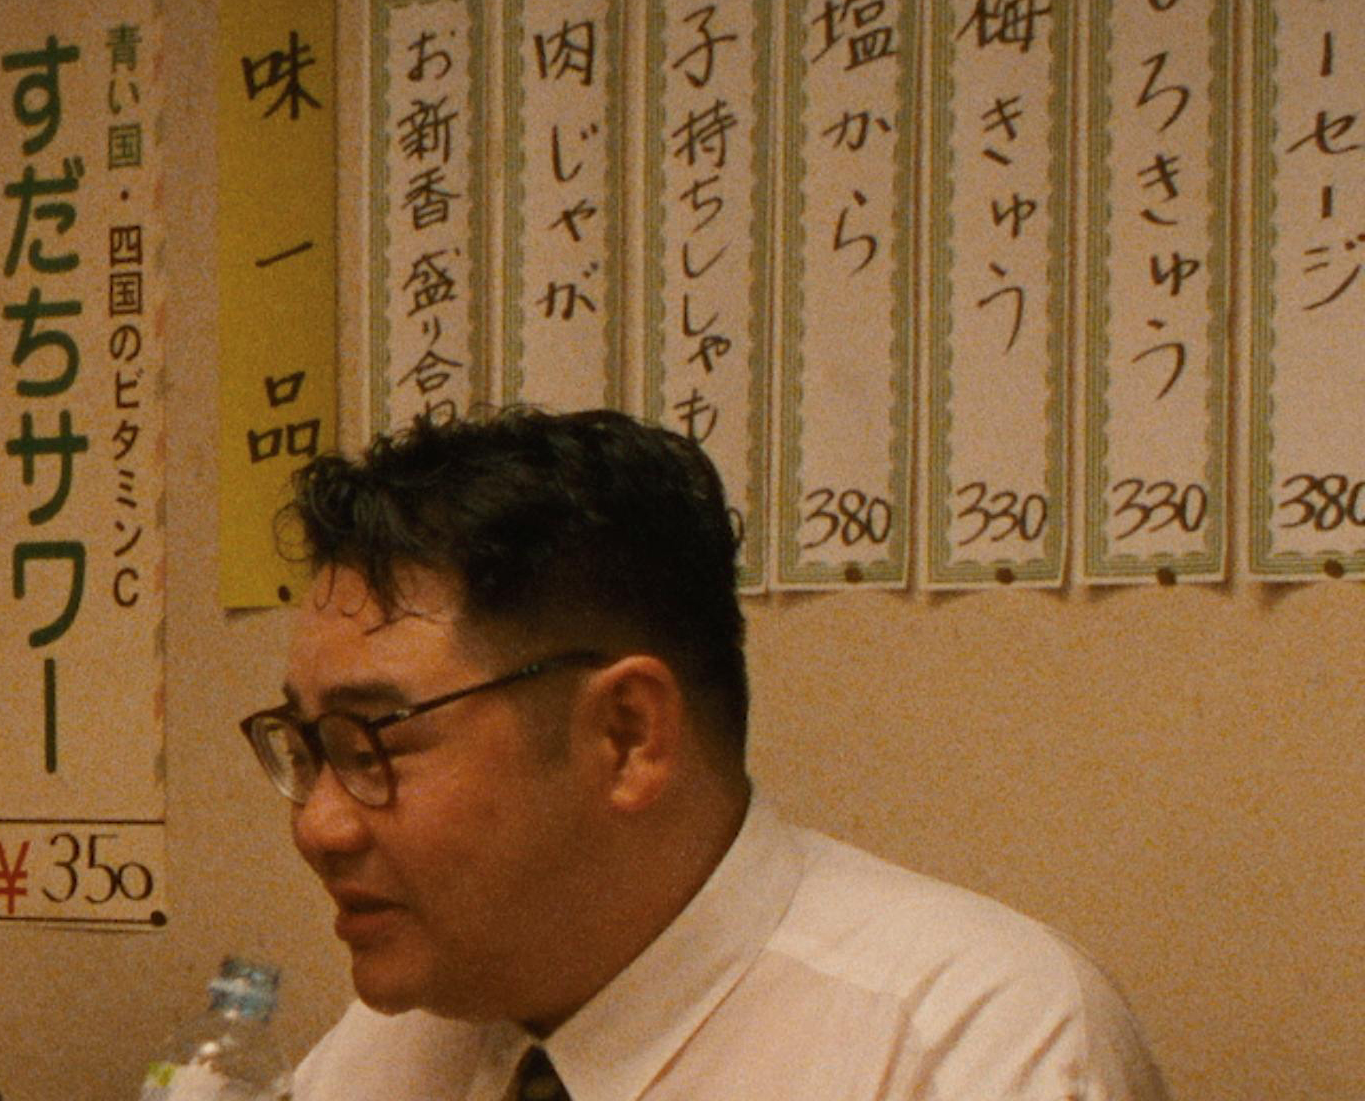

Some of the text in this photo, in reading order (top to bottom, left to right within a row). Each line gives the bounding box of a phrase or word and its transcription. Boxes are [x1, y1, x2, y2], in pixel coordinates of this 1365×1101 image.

[241, 30, 323, 464] 味一品
[534, 19, 599, 321] 肉じゃが
[672, 4, 739, 444] 子持ちししゃも
[811, 0, 901, 277] 塩から
[1131, 0, 1201, 401] ろきゅう
[1, 35, 90, 774] すだちサワー
[105, 22, 144, 609] 青い国・四国のビタミンC
[803, 487, 893, 550] 380
[955, 481, 1048, 547] 330
[1112, 477, 1209, 541] 330
